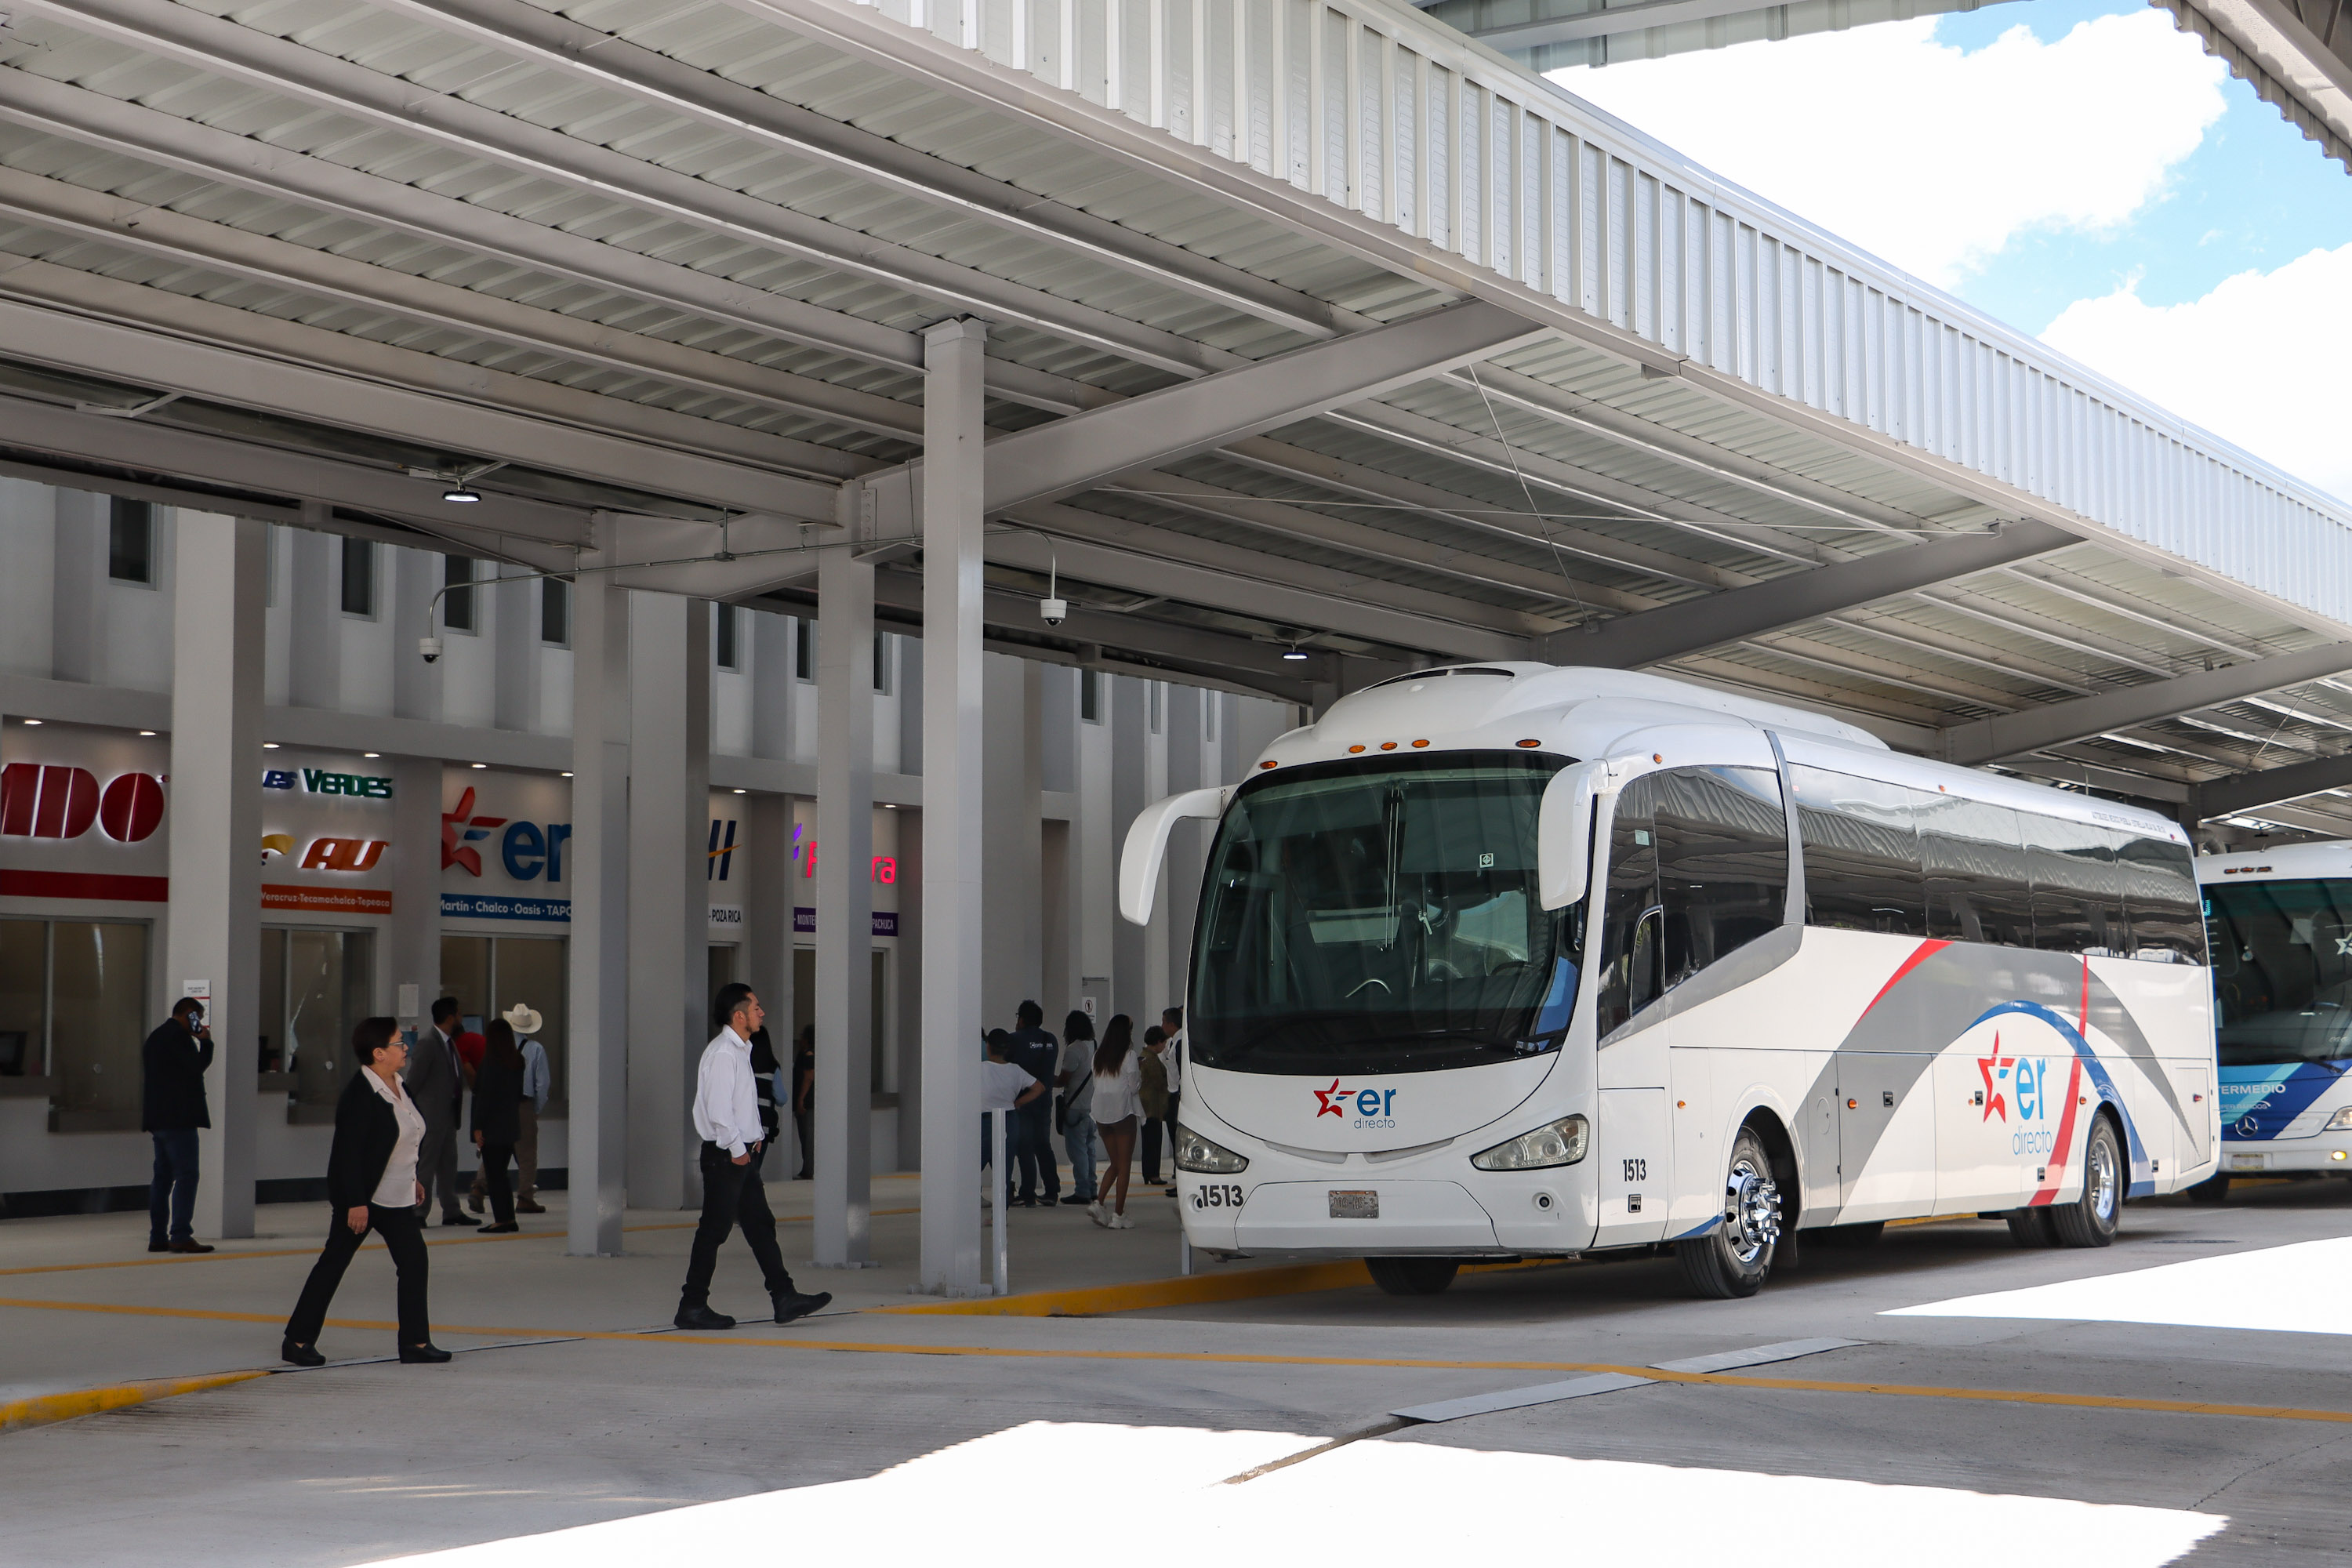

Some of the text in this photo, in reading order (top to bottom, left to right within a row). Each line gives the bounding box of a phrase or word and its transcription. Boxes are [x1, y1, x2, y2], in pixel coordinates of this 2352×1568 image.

[300, 768, 393, 799] VERDES
[299, 838, 390, 872] AU
[503, 821, 572, 882] er
[475, 902, 509, 913] Chalco
[514, 903, 541, 915] Oasis
[712, 909, 742, 924] POZA RICA
[797, 914, 816, 926] MONTE
[872, 918, 894, 930] PACHUCA
[2016, 1057, 2046, 1120] er
[2219, 1084, 2286, 1094] ERMEDIO
[1356, 1088, 1396, 1116] er
[1353, 1117, 1396, 1129] directo
[2013, 1124, 2053, 1155] directo
[1623, 1158, 1646, 1182] 1513
[1200, 1185, 1244, 1207] 1513
